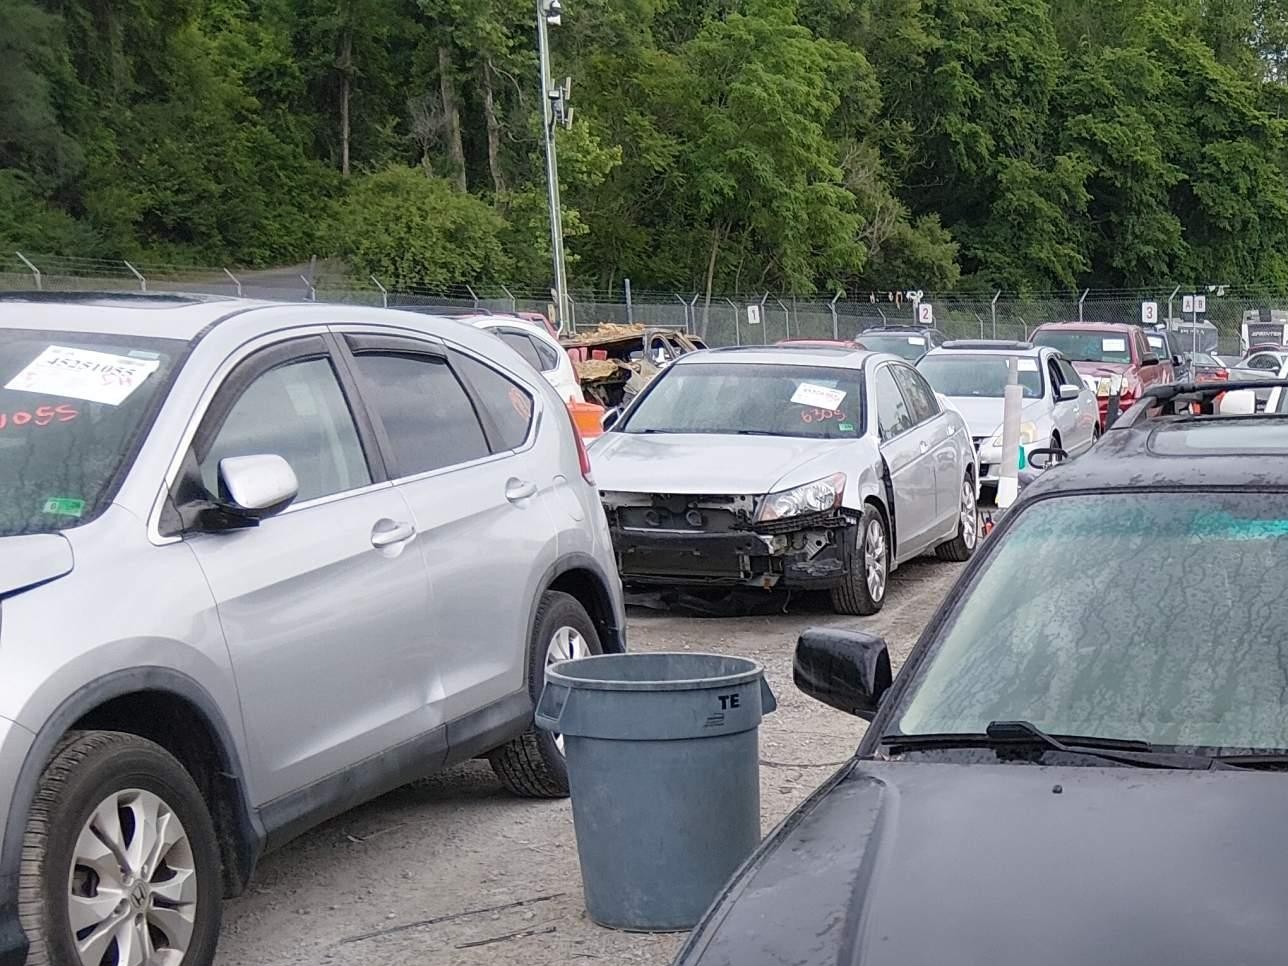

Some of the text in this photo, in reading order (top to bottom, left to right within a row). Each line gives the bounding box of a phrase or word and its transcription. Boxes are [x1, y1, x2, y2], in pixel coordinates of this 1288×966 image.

[750, 309, 758, 321] 1
[922, 308, 930, 320] 2
[1146, 306, 1153, 319] 3
